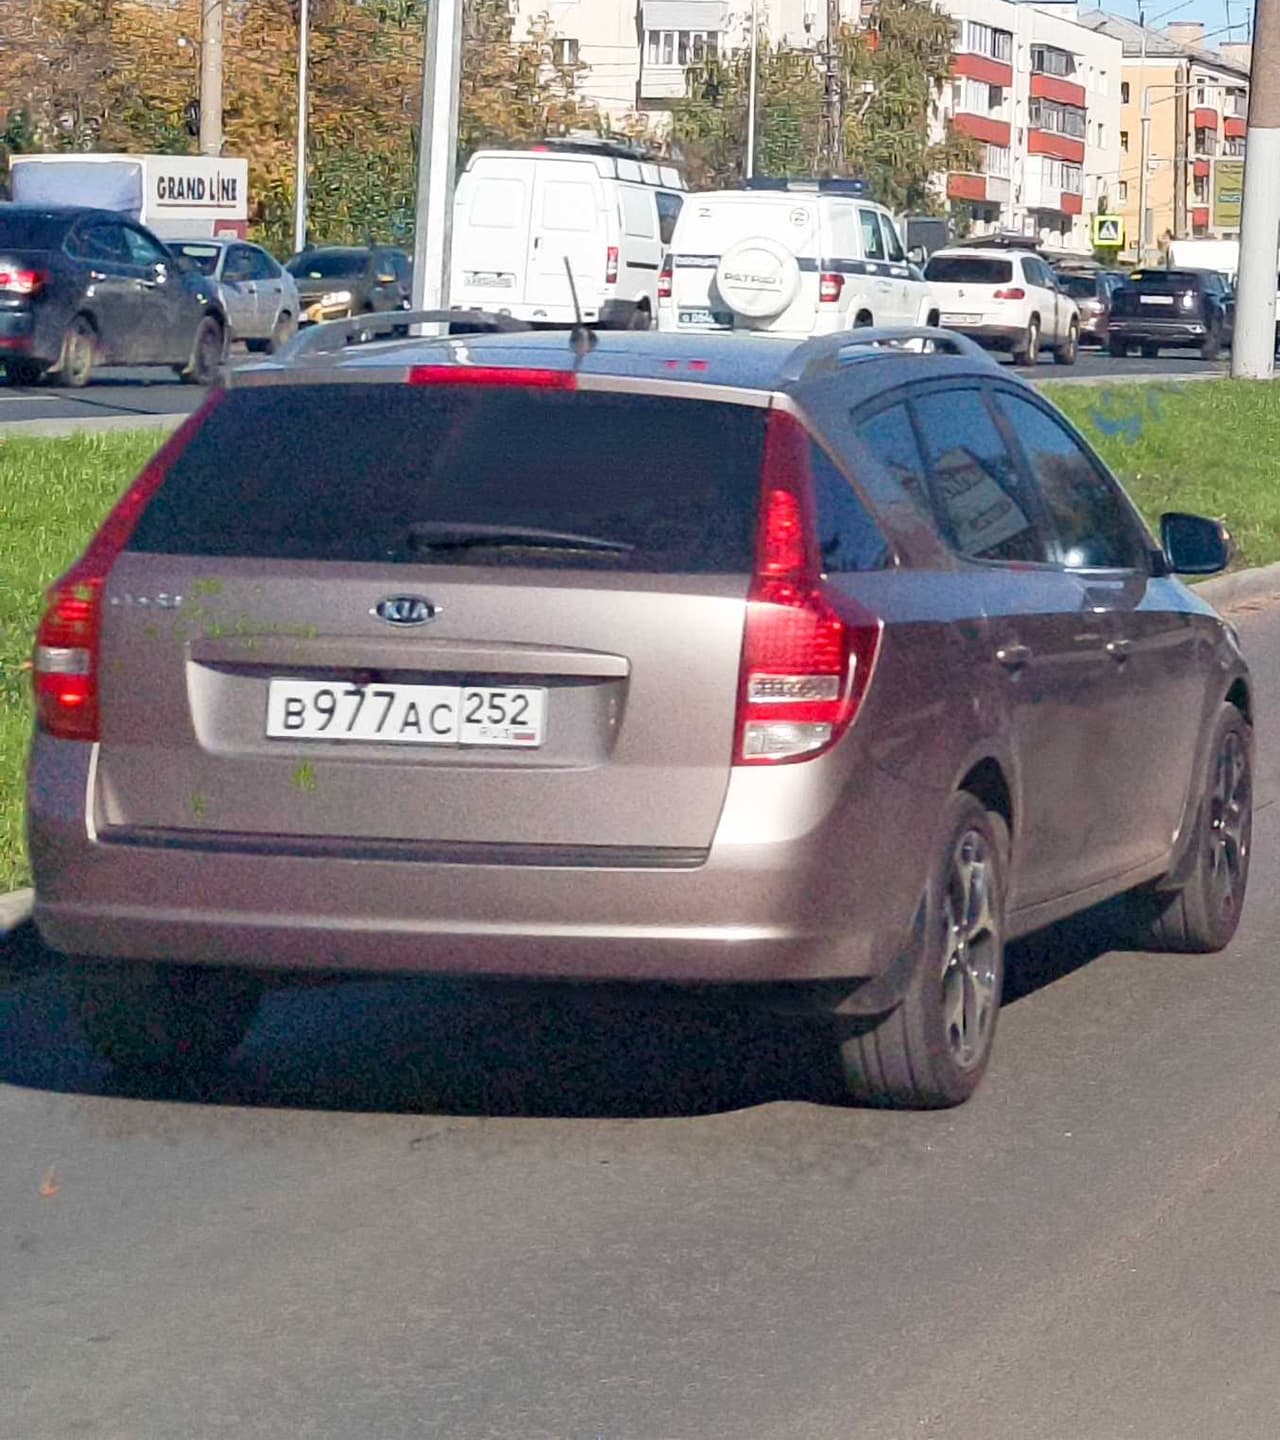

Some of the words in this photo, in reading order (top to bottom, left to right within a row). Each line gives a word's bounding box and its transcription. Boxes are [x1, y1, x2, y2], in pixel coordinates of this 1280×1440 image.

[157, 175, 206, 200] GRAND
[209, 170, 238, 202] LINE
[384, 600, 428, 619] KIA
[283, 689, 453, 735] В977АС
[464, 692, 530, 725] 252
